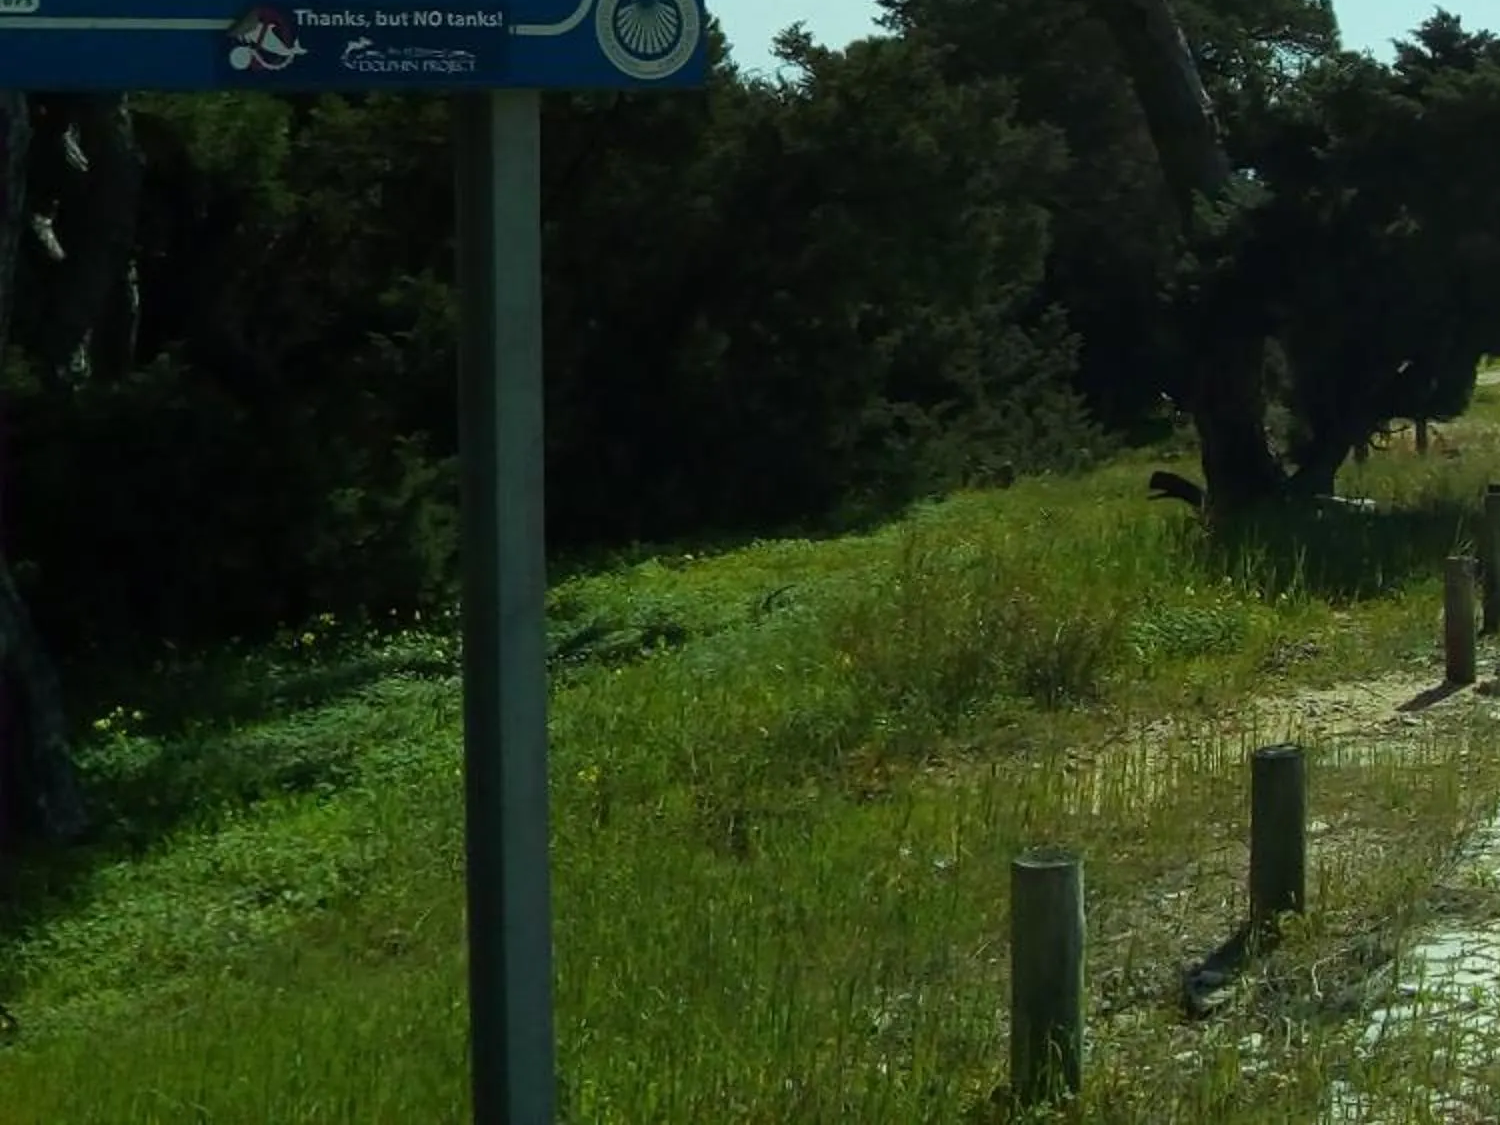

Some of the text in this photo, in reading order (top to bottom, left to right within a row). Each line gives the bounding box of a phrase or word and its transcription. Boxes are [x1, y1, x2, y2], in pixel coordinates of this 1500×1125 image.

[294, 9, 504, 28] Thanks, but NO tanks!
[358, 59, 477, 74] DOLPHIN PROJECT
